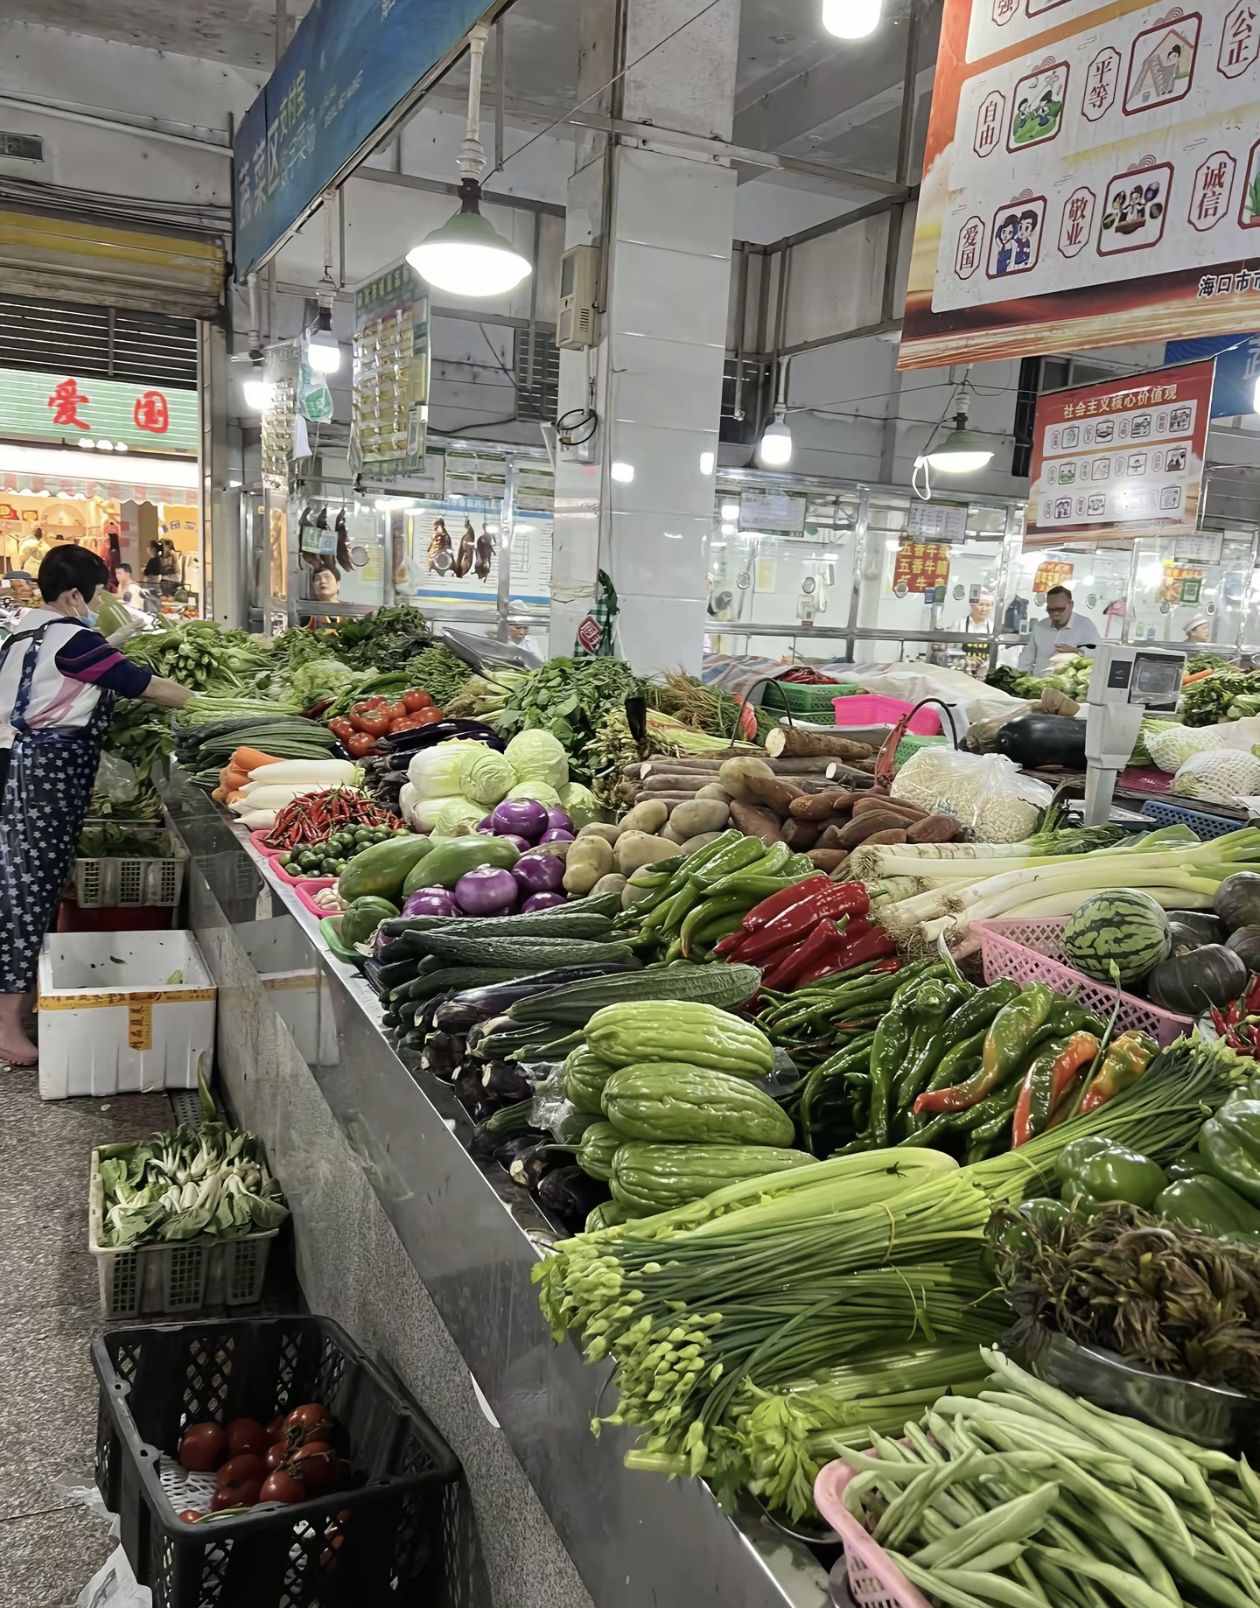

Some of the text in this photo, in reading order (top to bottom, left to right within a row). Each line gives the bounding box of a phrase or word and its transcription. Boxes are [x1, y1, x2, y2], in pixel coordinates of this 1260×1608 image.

[1226, 6, 1256, 66] 公正
[1088, 55, 1114, 110] 平等
[979, 100, 998, 151] 自由
[1196, 159, 1227, 219] 诚信
[959, 223, 980, 271] 爱国
[1064, 196, 1089, 248] 敬业
[1197, 269, 1260, 298] 海口市
[1063, 383, 1177, 419] 社会主义核心价值观
